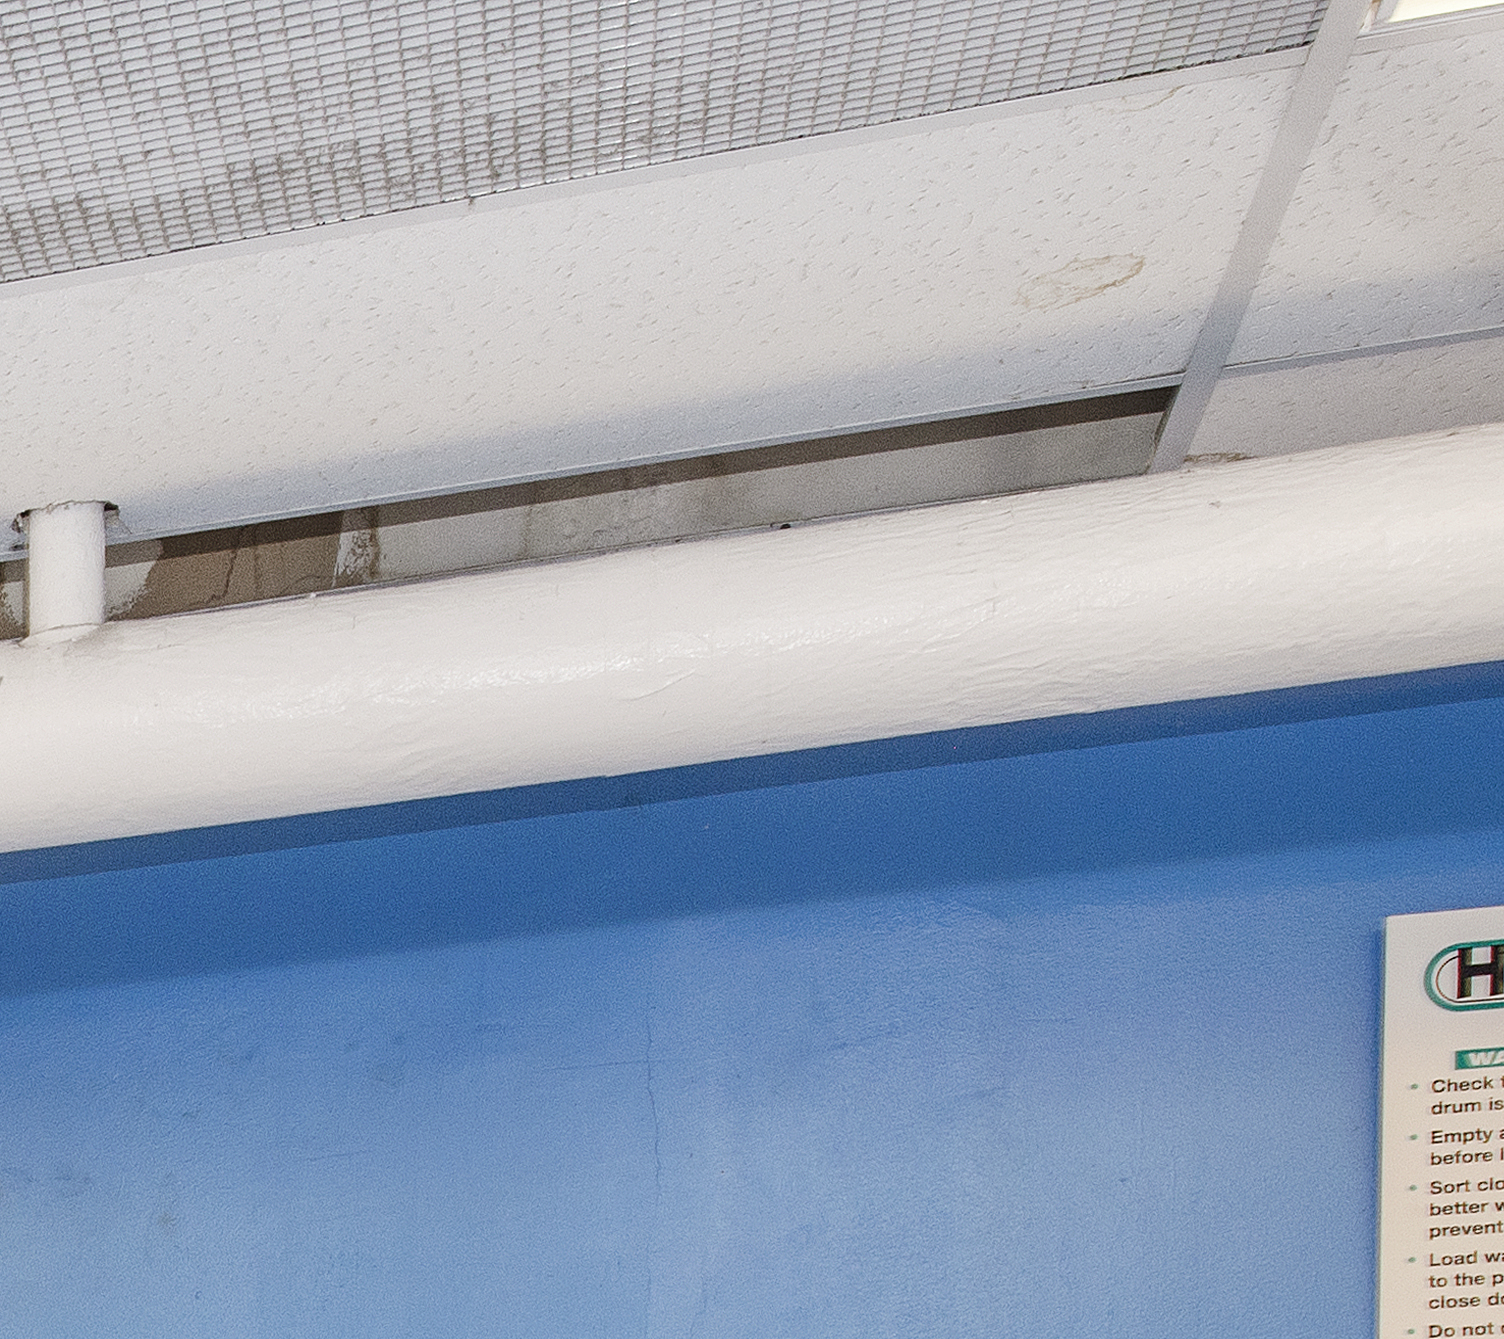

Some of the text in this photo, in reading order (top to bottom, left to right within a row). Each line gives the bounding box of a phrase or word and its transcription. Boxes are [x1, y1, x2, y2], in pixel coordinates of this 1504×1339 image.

[1431, 1076, 1494, 1093] Check
[1431, 1100, 1481, 1115] drum
[1431, 1128, 1493, 1145] Empty
[1430, 1147, 1493, 1166] before
[1430, 1179, 1470, 1195] Sort
[1429, 1201, 1488, 1217] better
[1430, 1251, 1477, 1267] Load
[1428, 1272, 1485, 1288] to the
[1429, 1295, 1480, 1309] close
[1428, 1321, 1494, 1339] Do not
